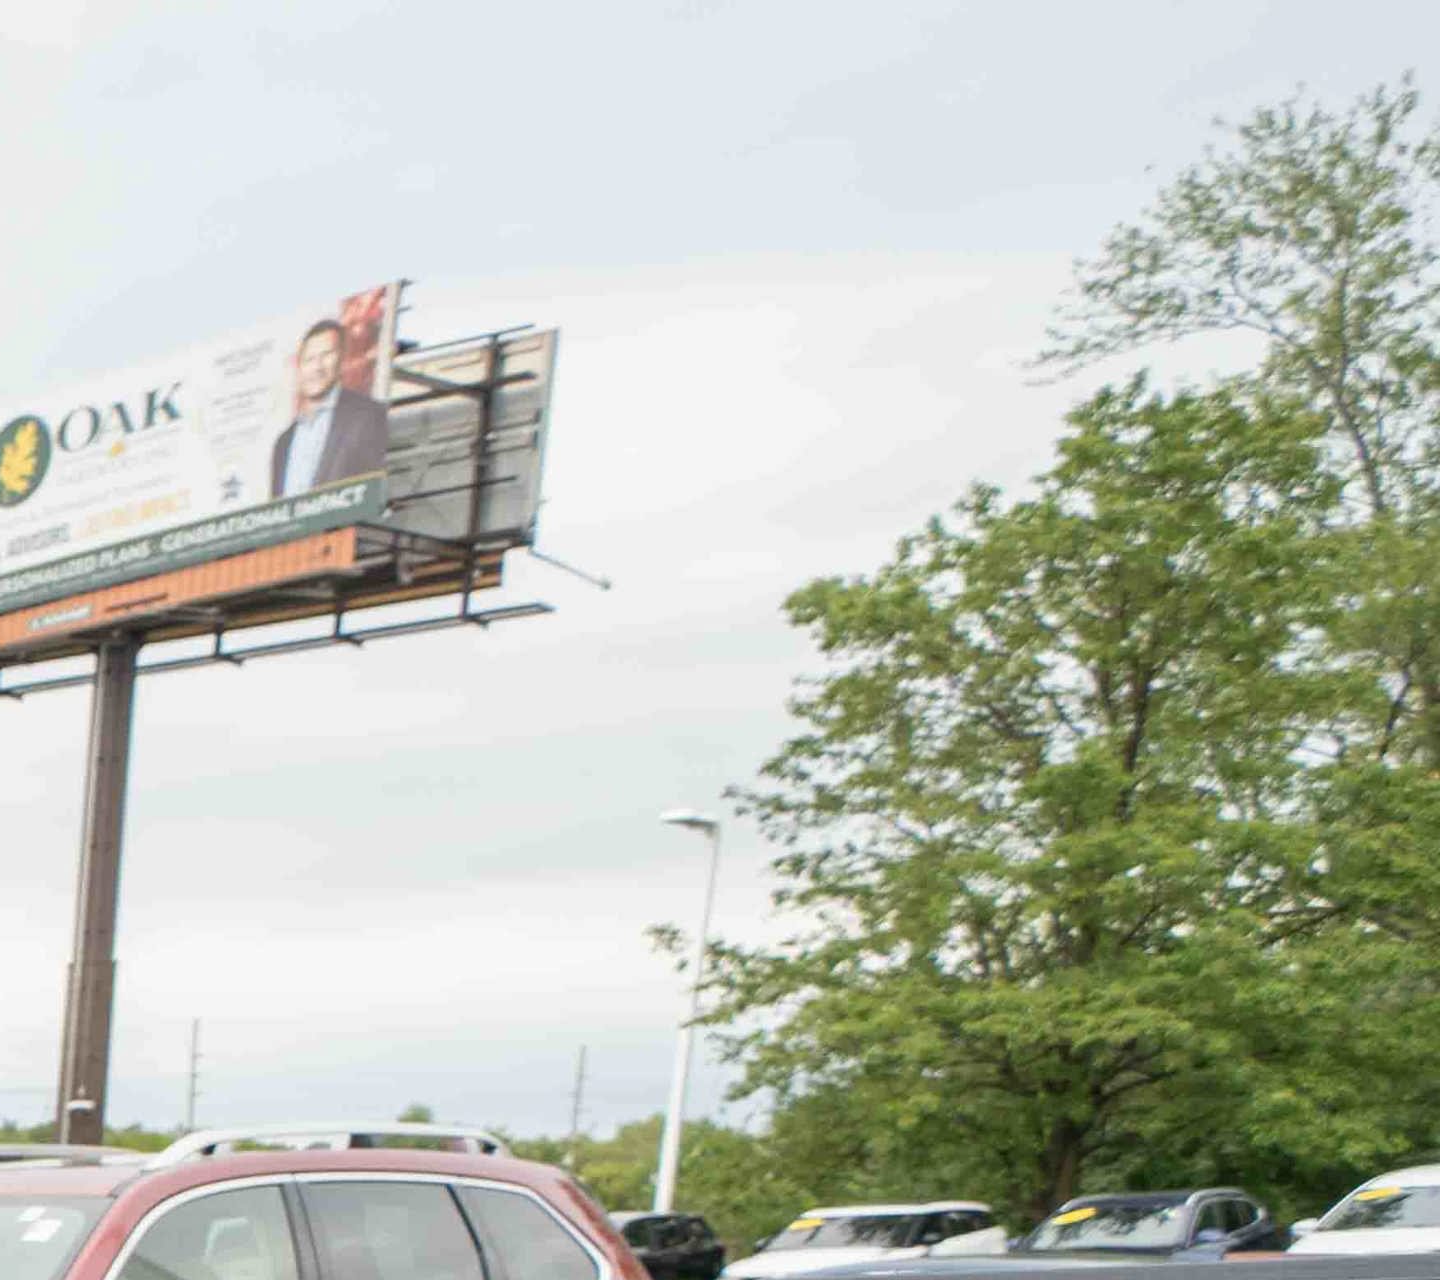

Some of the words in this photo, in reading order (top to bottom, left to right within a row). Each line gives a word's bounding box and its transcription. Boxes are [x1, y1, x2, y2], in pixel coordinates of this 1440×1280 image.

[57, 379, 182, 452] OAK
[99, 540, 150, 570] PLANS
[159, 502, 291, 552] GENERATIONAL
[293, 484, 368, 518] IMPACT
